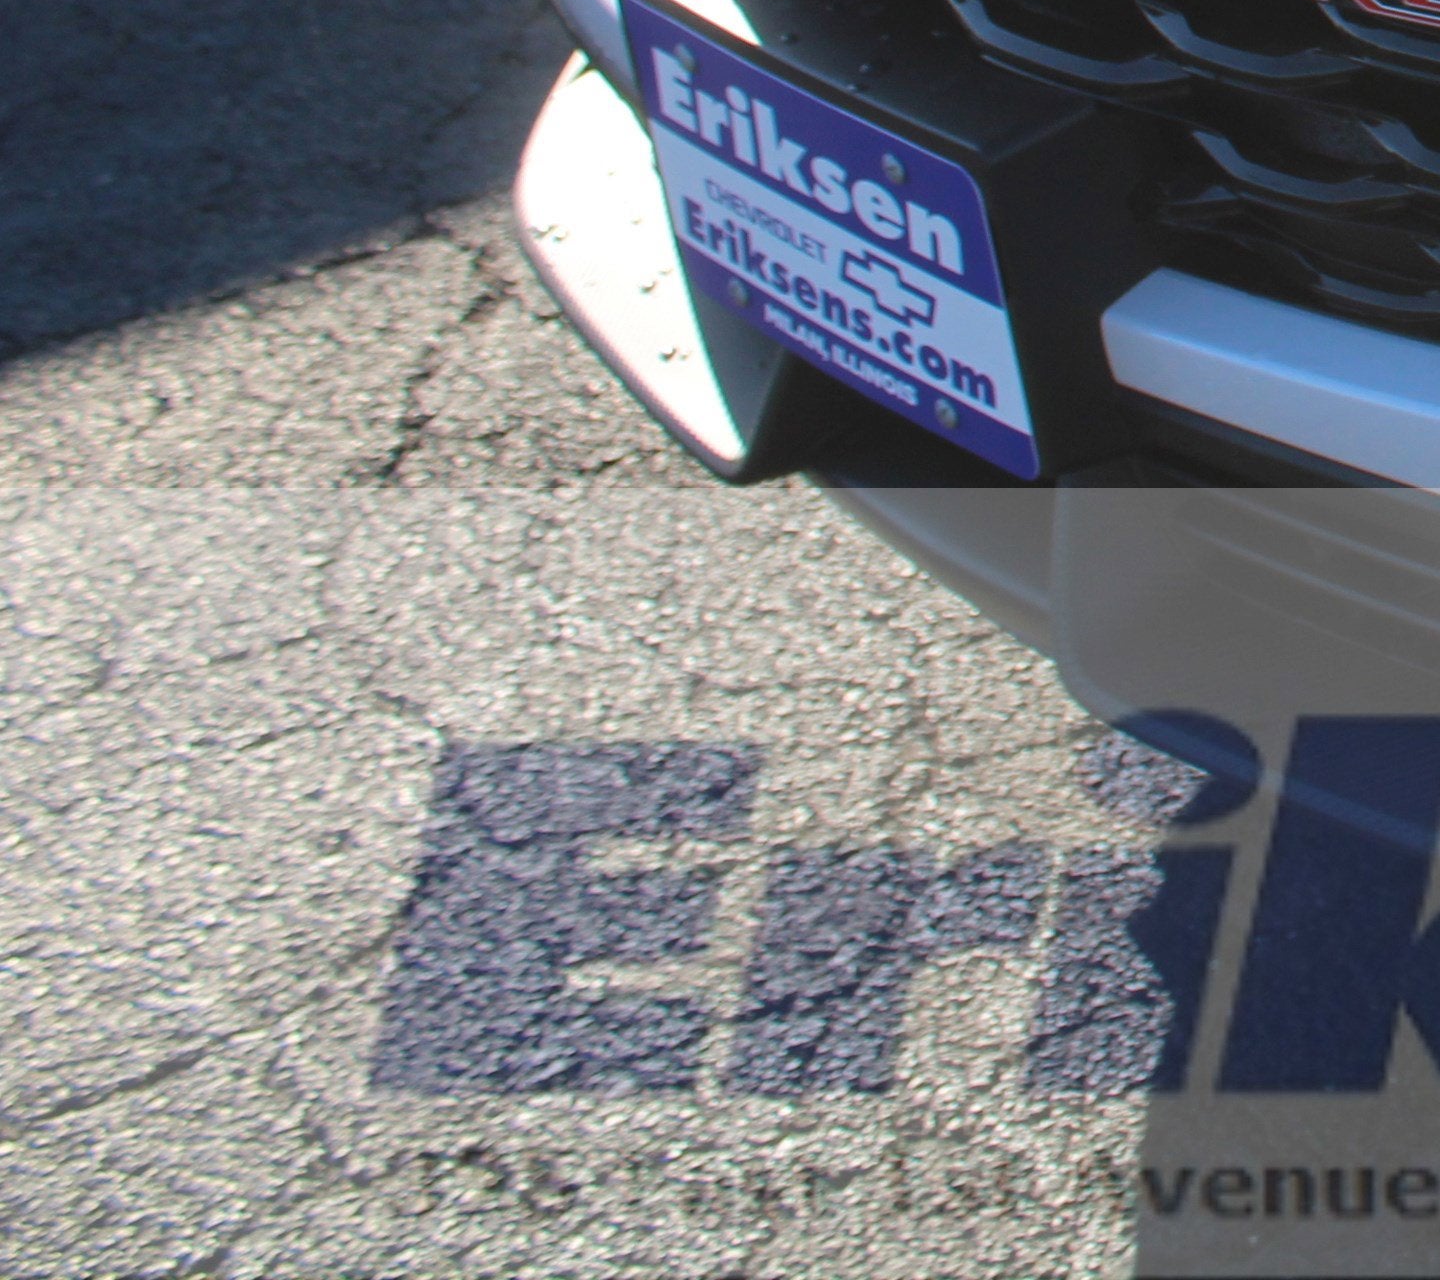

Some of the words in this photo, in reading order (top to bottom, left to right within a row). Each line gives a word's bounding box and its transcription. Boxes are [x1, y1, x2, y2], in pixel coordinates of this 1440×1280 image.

[651, 47, 965, 276] Eriksen
[705, 177, 828, 266] CHEVROLET
[683, 195, 998, 409] Eriksens.com
[829, 348, 921, 408] ILLINOIS
